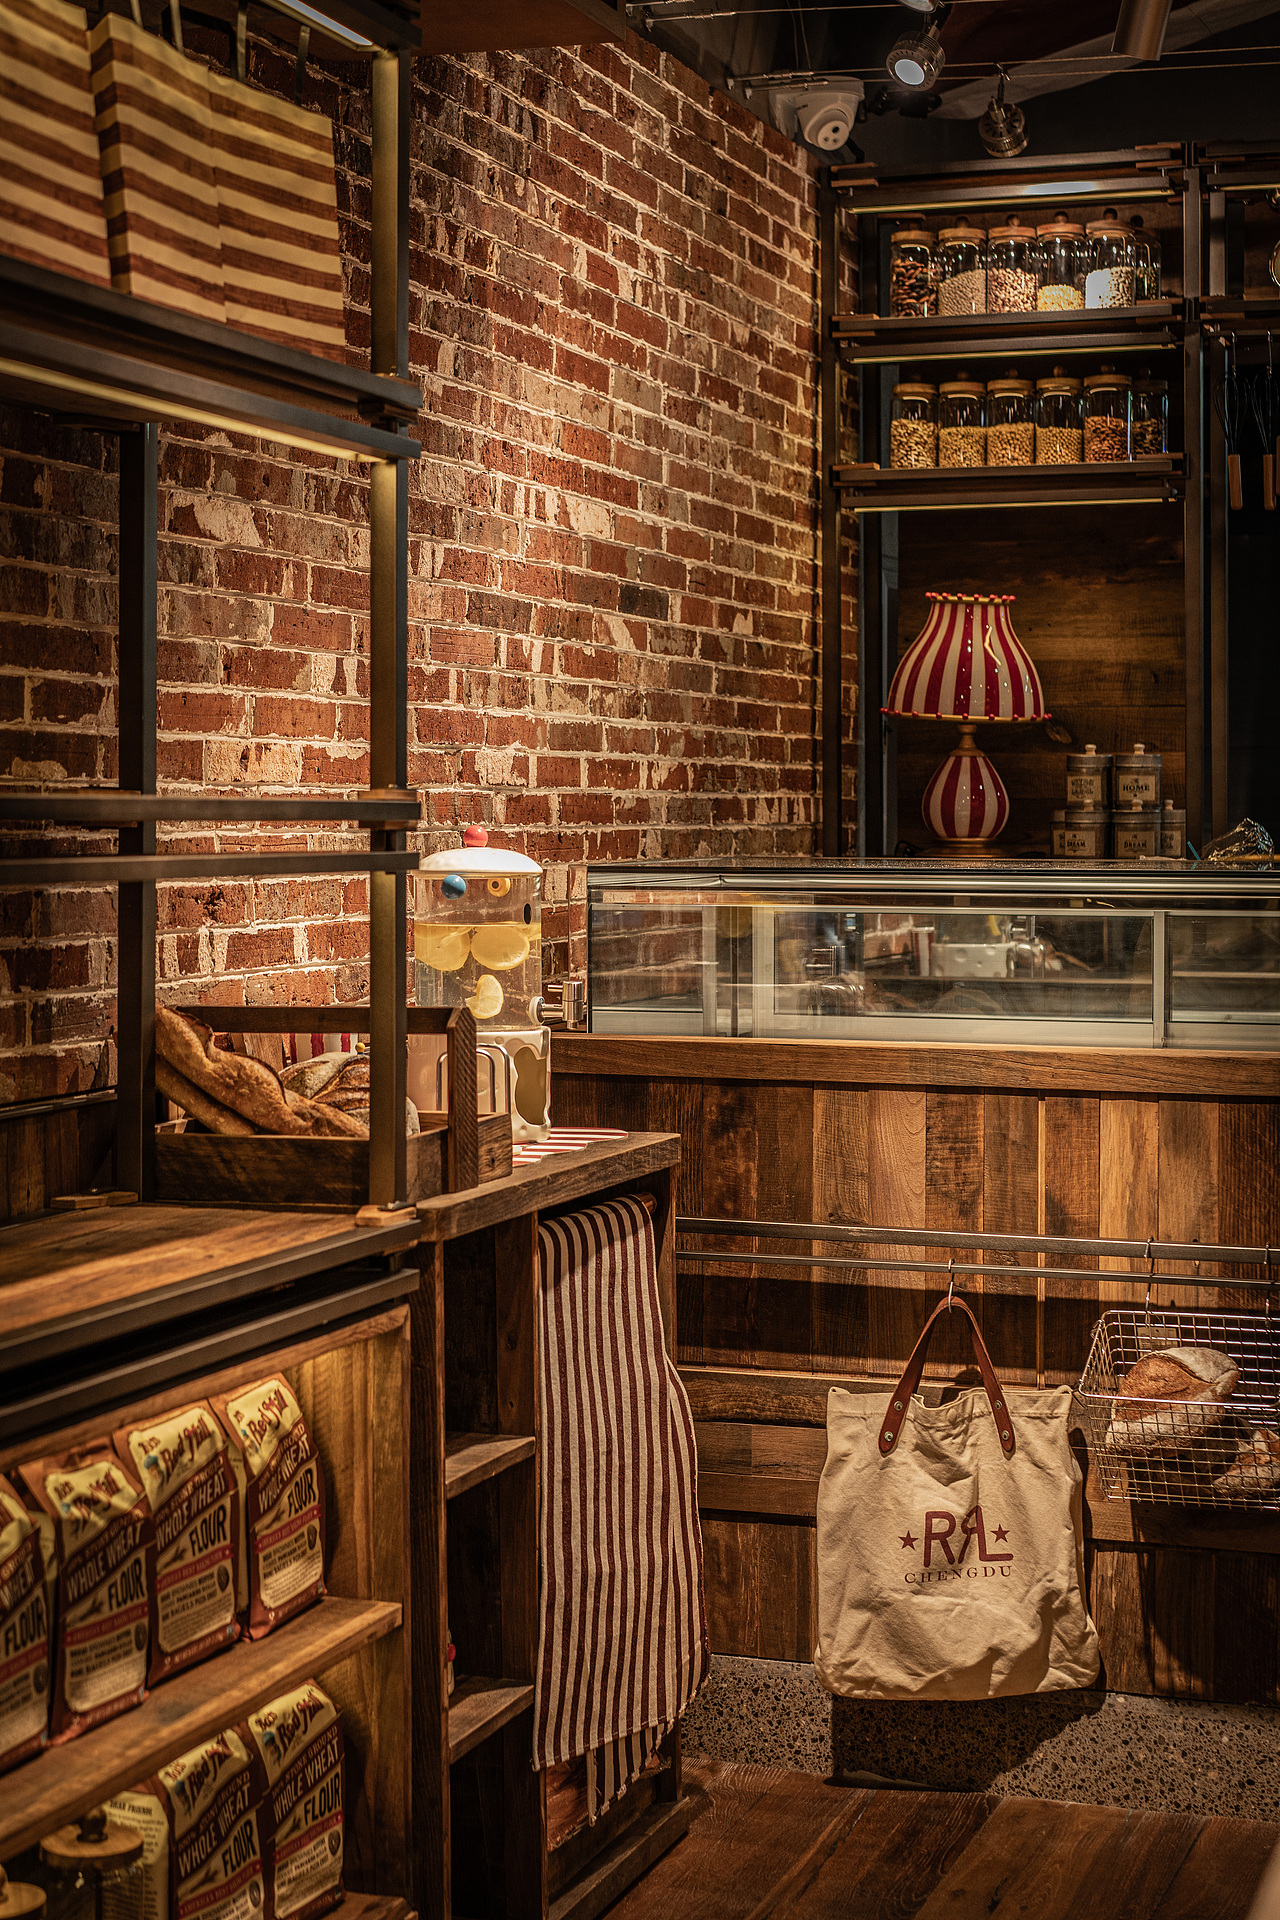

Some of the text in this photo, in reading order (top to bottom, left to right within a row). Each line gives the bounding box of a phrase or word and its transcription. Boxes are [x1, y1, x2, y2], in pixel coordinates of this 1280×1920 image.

[281, 1433, 311, 1482] WHEAT
[156, 1500, 189, 1553] WHOLE
[190, 1467, 226, 1518] WHEAT
[288, 1467, 316, 1518] FLOUR
[189, 1504, 228, 1557] FLOUR
[66, 1553, 106, 1603] WHOLE
[105, 1519, 145, 1569] WHEAT
[108, 1556, 146, 1612] FLOUR
[904, 1564, 1013, 1584] CHENGDU
[4, 1597, 47, 1658] FLOUR
[273, 1773, 304, 1826] WHOLE
[304, 1736, 340, 1788] WHEAT
[303, 1771, 341, 1826] FLOUR
[177, 1822, 218, 1880] WHOLE
[216, 1783, 251, 1836] WHEAT
[221, 1818, 258, 1879] FLOUR
